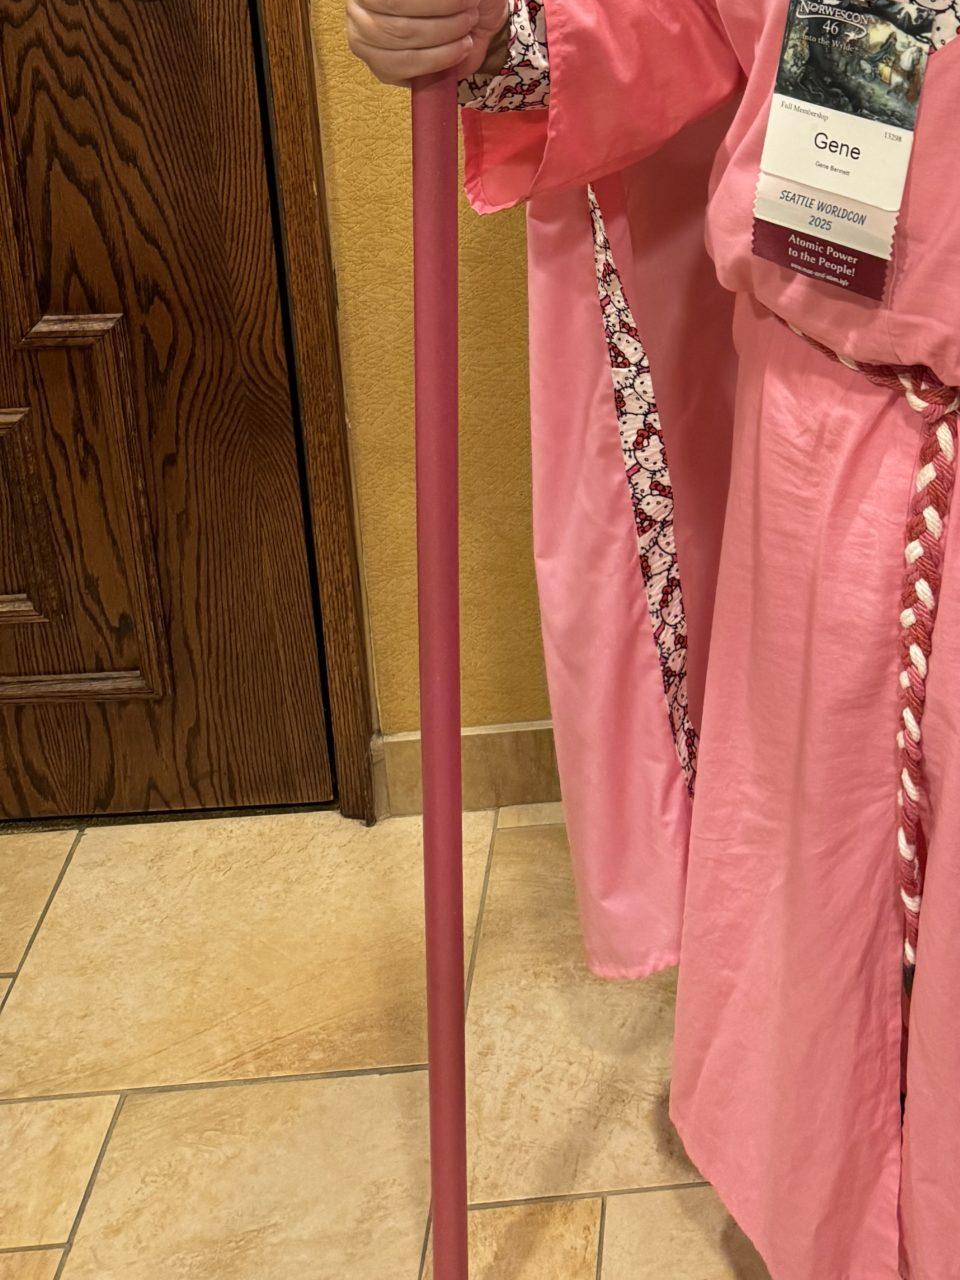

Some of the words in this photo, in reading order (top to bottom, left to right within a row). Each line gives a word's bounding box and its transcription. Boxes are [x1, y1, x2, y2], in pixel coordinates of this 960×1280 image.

[800, 0, 868, 25] NORWESCON
[822, 20, 840, 35] 46
[780, 101, 793, 110] Full
[793, 105, 829, 122] Membership
[814, 132, 861, 160] Gene
[815, 160, 830, 170] Gene
[780, 190, 816, 209] SEATTLE
[816, 200, 868, 226] WORLDCON
[808, 215, 833, 231] 2025
[788, 234, 825, 253] Atomic
[826, 245, 858, 264] Power
[788, 247, 799, 257] to
[800, 251, 816, 264] the
[818, 256, 856, 277] People!
